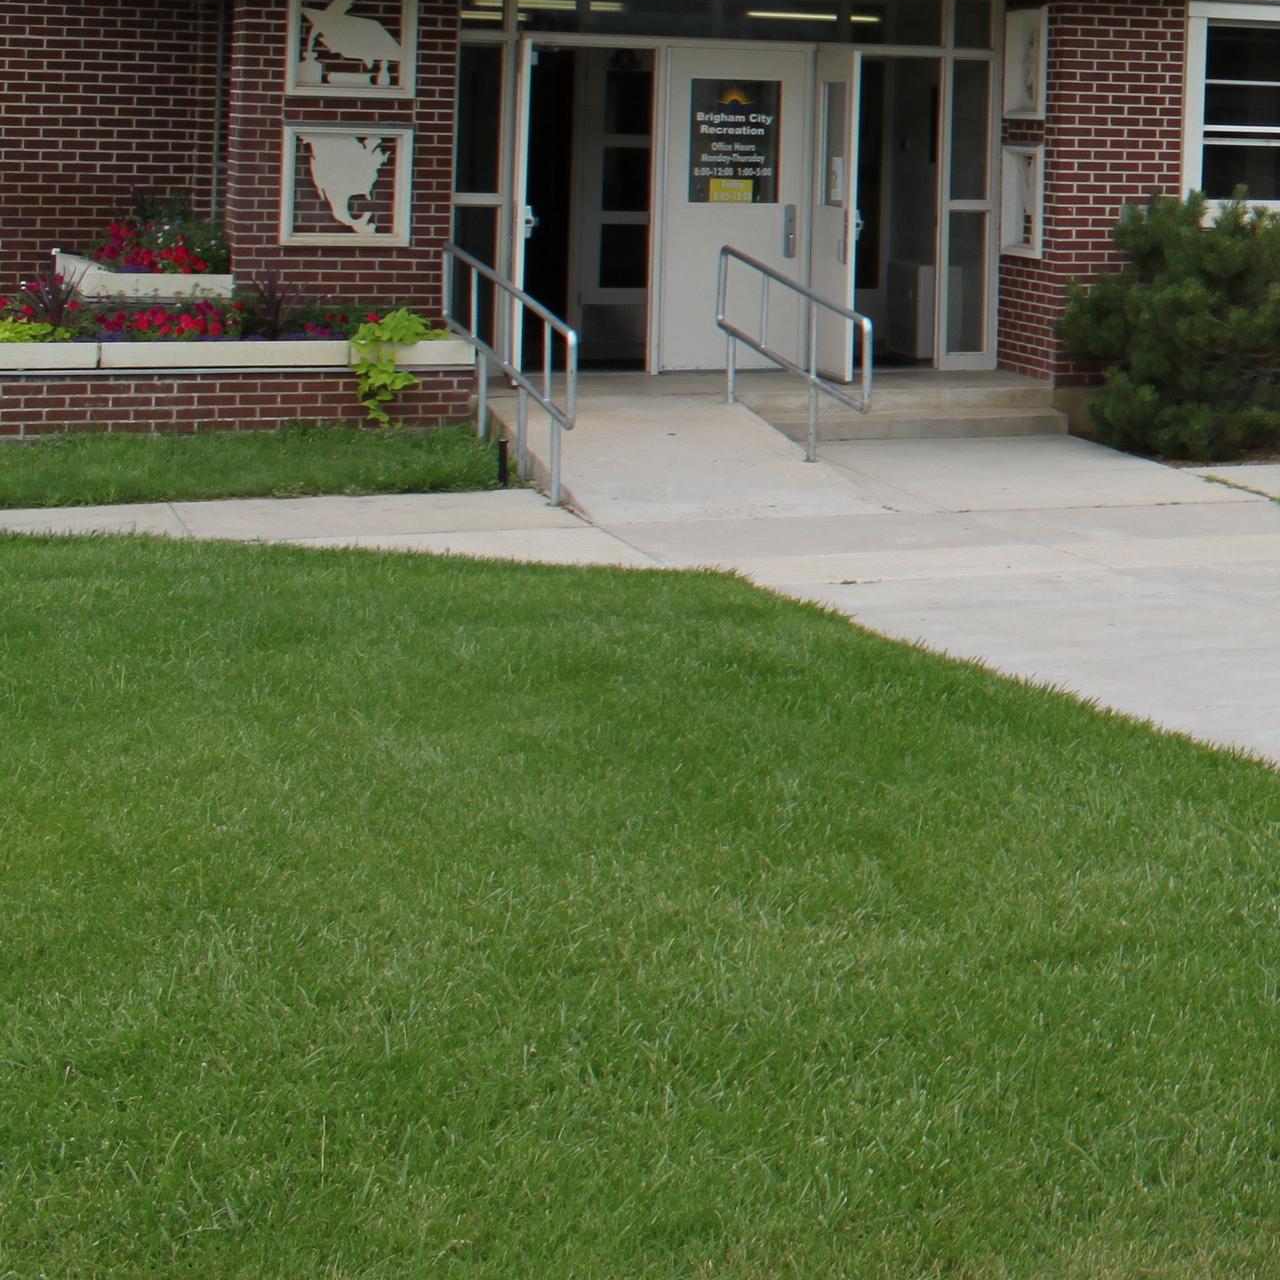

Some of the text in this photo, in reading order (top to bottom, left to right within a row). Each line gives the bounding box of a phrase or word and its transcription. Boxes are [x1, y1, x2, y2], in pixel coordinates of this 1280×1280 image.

[697, 112, 773, 125] Brigham City
[700, 124, 765, 135] Recreation
[711, 142, 755, 151] Office Hours
[701, 153, 766, 164] Monday-Thursday
